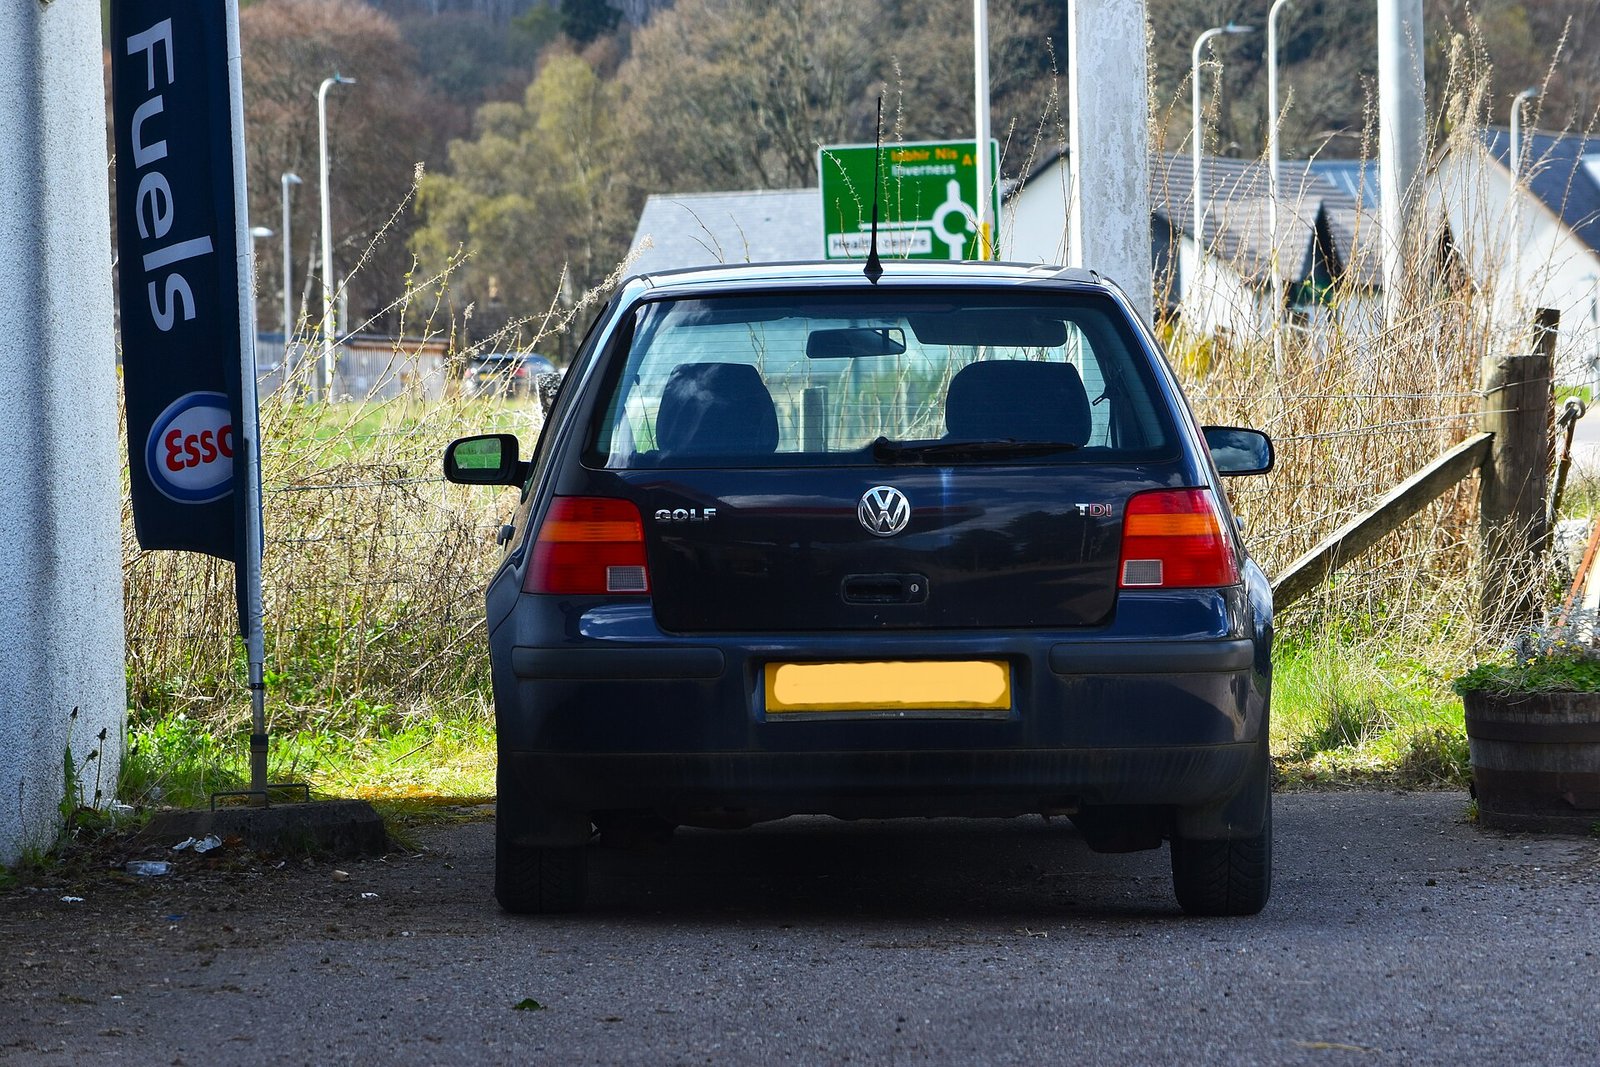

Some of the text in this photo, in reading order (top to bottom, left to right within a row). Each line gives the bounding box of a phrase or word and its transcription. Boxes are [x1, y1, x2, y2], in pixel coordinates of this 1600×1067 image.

[127, 17, 214, 332] Fuels
[655, 508, 717, 521] GOLF
[1075, 503, 1113, 517] TDI
